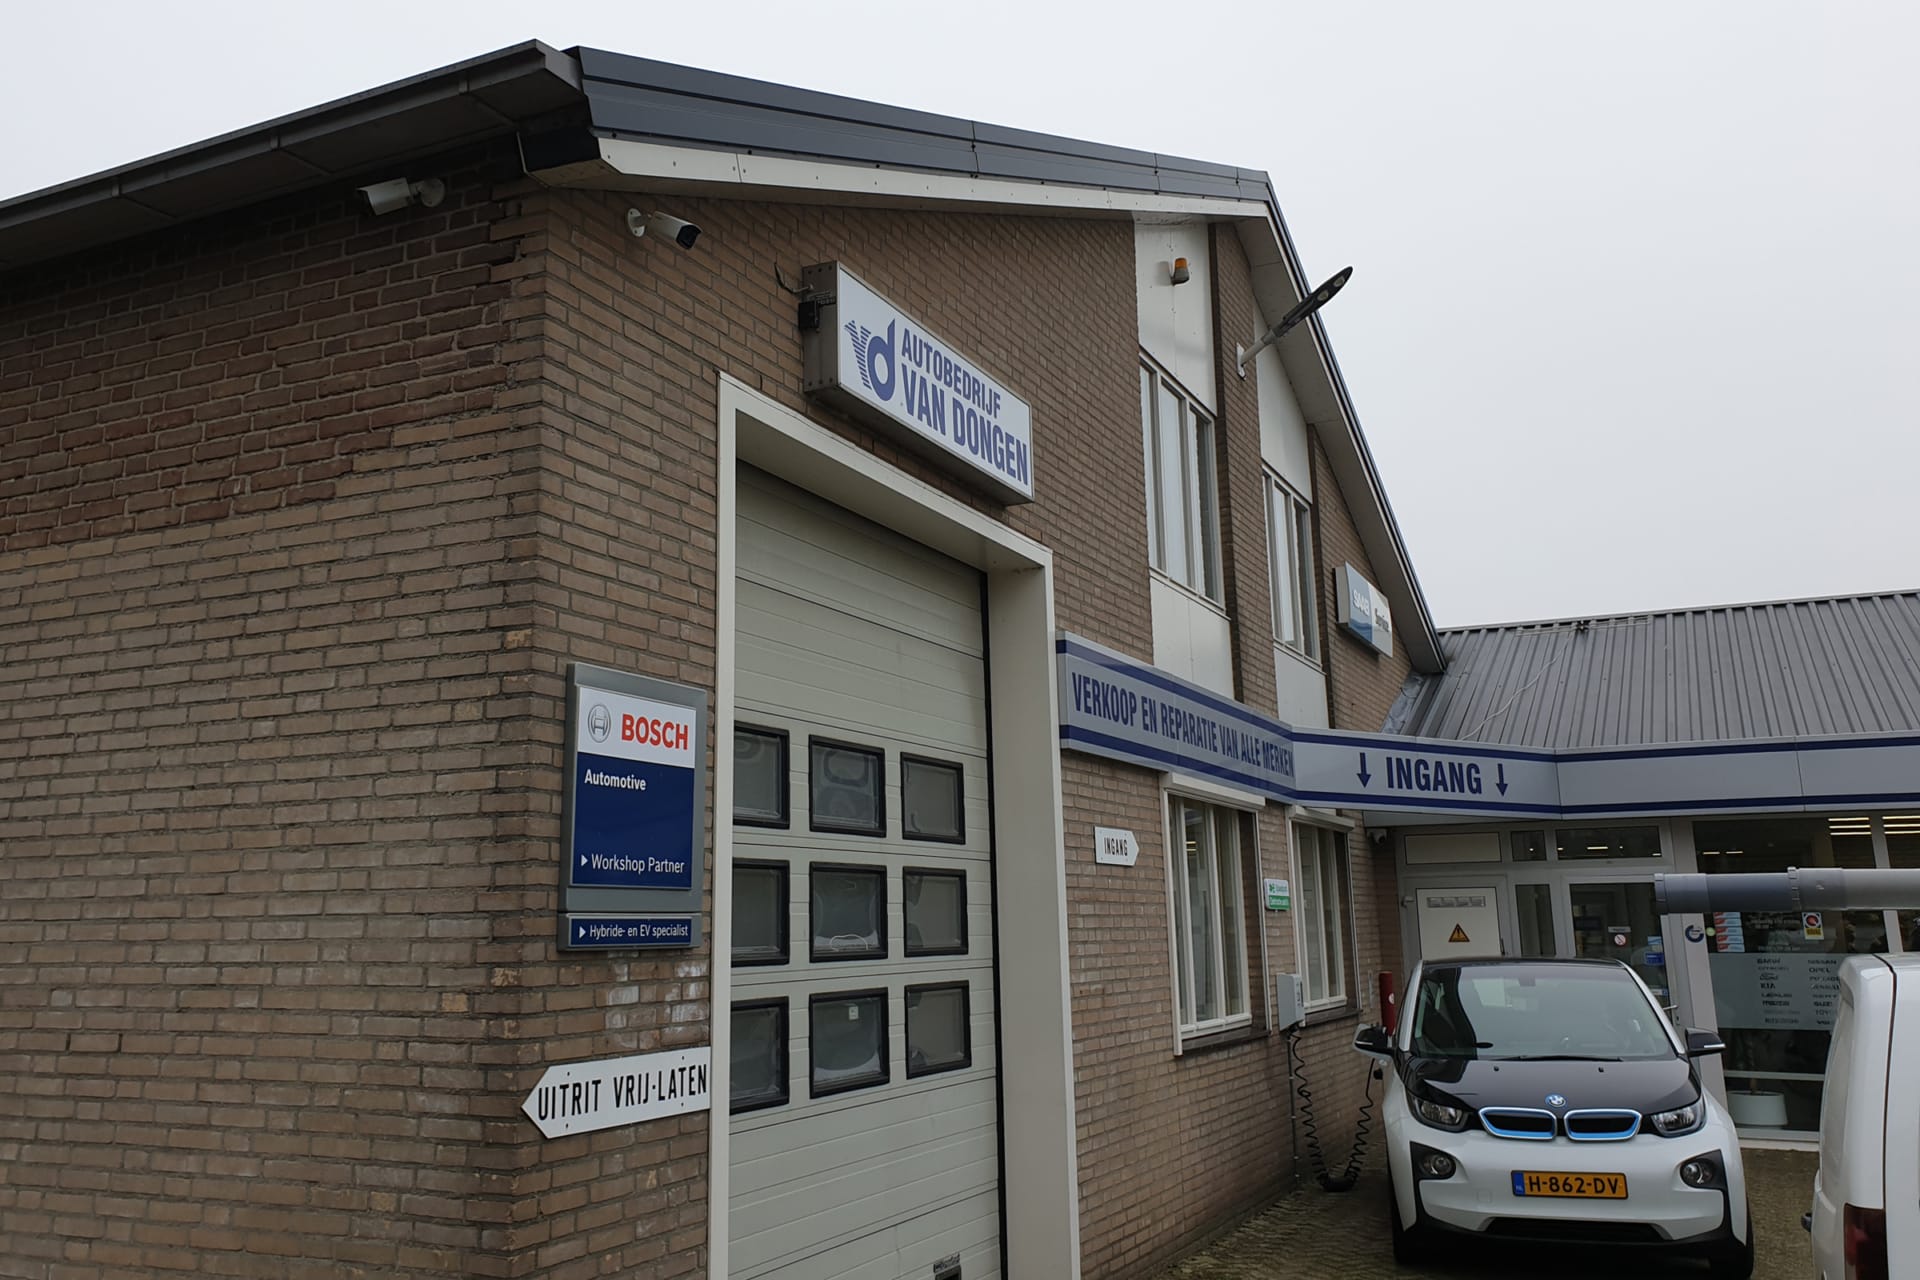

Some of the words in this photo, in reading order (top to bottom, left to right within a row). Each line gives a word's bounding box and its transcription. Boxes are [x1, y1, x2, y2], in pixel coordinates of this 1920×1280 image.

[901, 328, 1001, 419] AUTOBEDRIJF
[901, 363, 946, 436] VAN
[952, 397, 1028, 486] DONGEN
[621, 713, 689, 751] BOSCH
[1072, 672, 1137, 727] VERKOOP
[1142, 696, 1158, 733] EN
[1160, 702, 1218, 753] REPARATIE
[1219, 724, 1239, 760] VAN
[1241, 733, 1261, 767] ALLE
[1262, 741, 1295, 777] MERKEN
[584, 769, 647, 791] Automotive
[1386, 756, 1482, 795] INGANG
[591, 853, 645, 875] Workshop
[648, 857, 685, 874] Partner
[1104, 837, 1128, 857] INGANG
[589, 924, 626, 944] Hybride-
[627, 928, 638, 938] en
[640, 924, 650, 937] EV
[651, 922, 689, 938] specialist
[538, 1079, 602, 1121] UITRIT
[1528, 1175, 1618, 1195] H-862-DV
